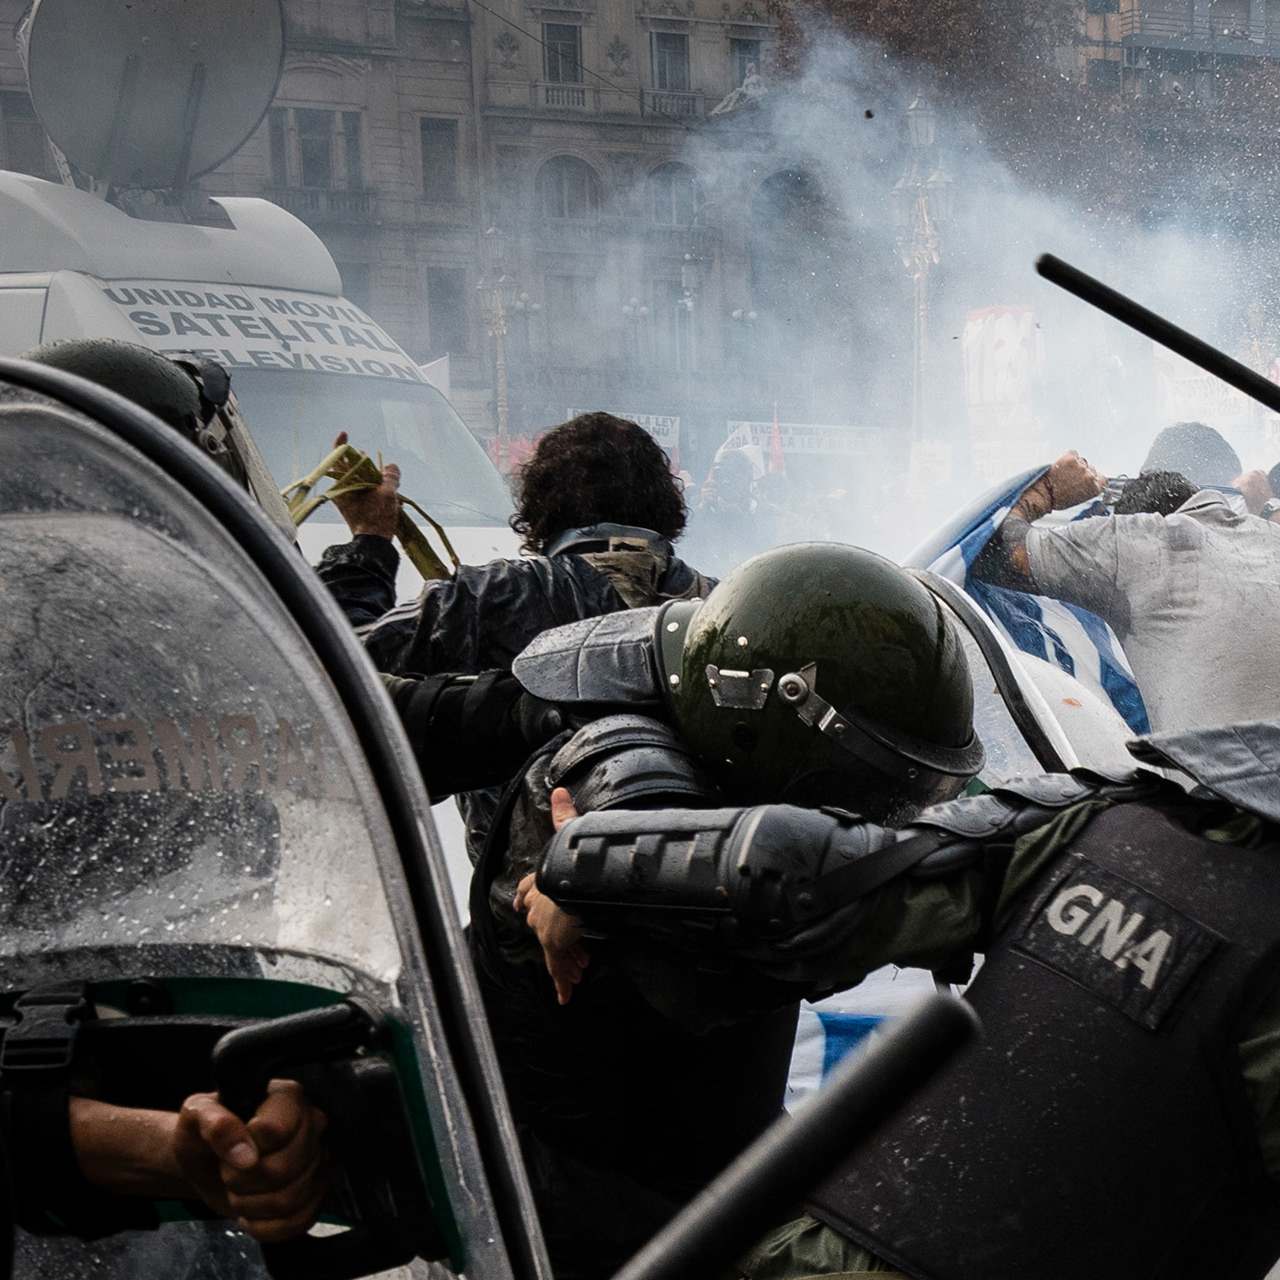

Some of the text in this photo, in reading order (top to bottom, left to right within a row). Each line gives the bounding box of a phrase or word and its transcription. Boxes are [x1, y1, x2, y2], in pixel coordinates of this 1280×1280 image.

[103, 287, 373, 326] UNIDAD MOVIL
[129, 310, 400, 352] SATELITAL
[203, 349, 428, 384] ELEVISION
[1047, 884, 1173, 990] GNA
